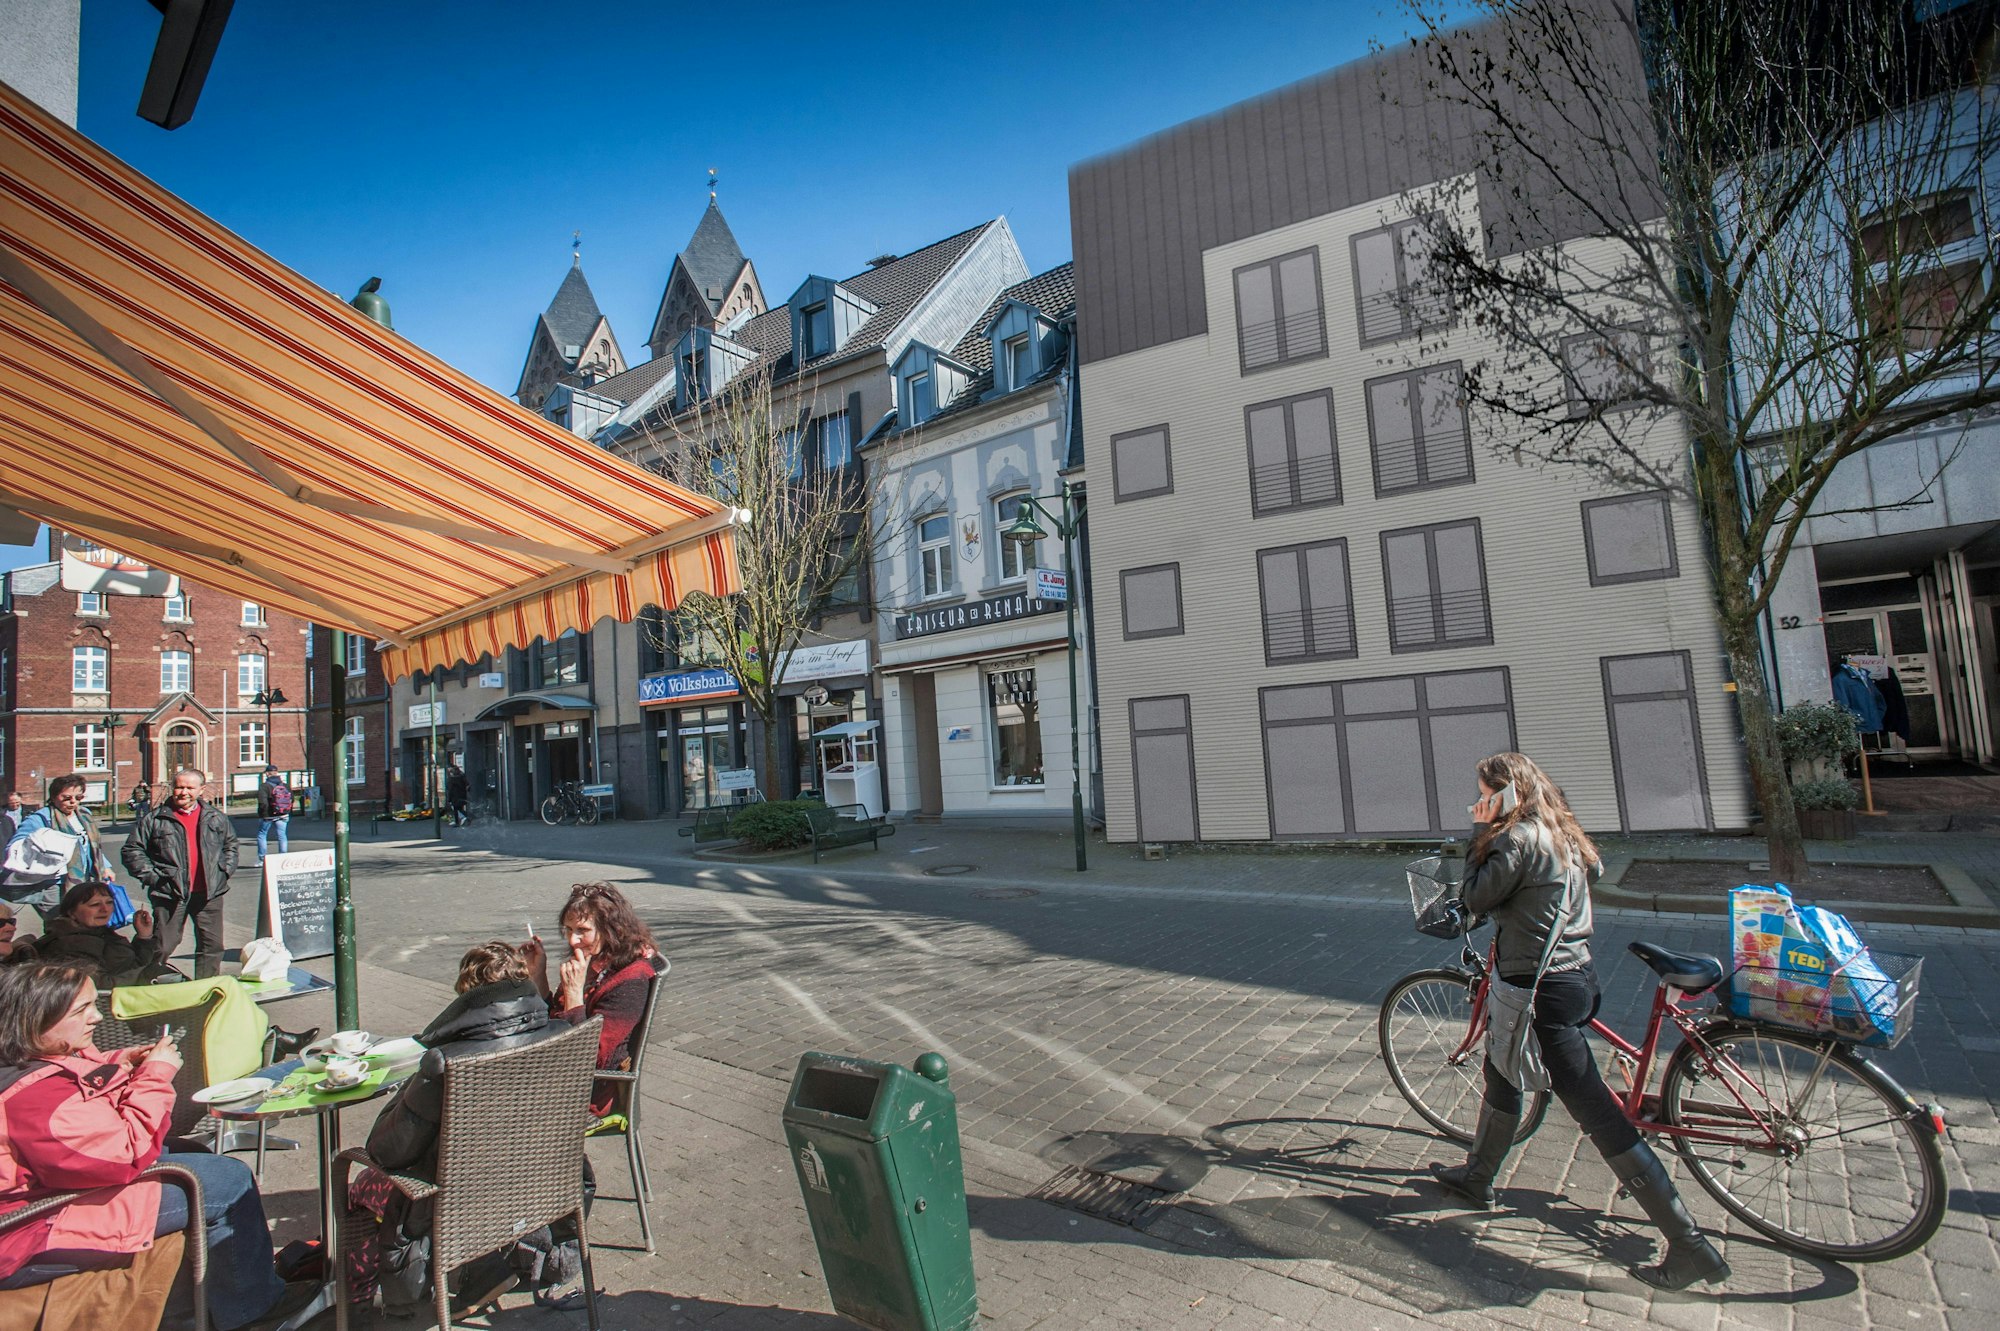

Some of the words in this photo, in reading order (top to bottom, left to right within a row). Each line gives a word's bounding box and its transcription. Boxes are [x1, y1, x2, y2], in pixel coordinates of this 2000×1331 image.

[85, 547, 107, 563] IM
[1050, 574, 1065, 586] Jung
[907, 607, 965, 634] FRISEUR
[984, 595, 1043, 620] RENATO
[1780, 616, 1802, 629] 52
[820, 643, 862, 662] Dorf
[668, 671, 735, 693] Volksbank
[991, 670, 1034, 686] FRISEU
[1787, 951, 1826, 972] TEDi
